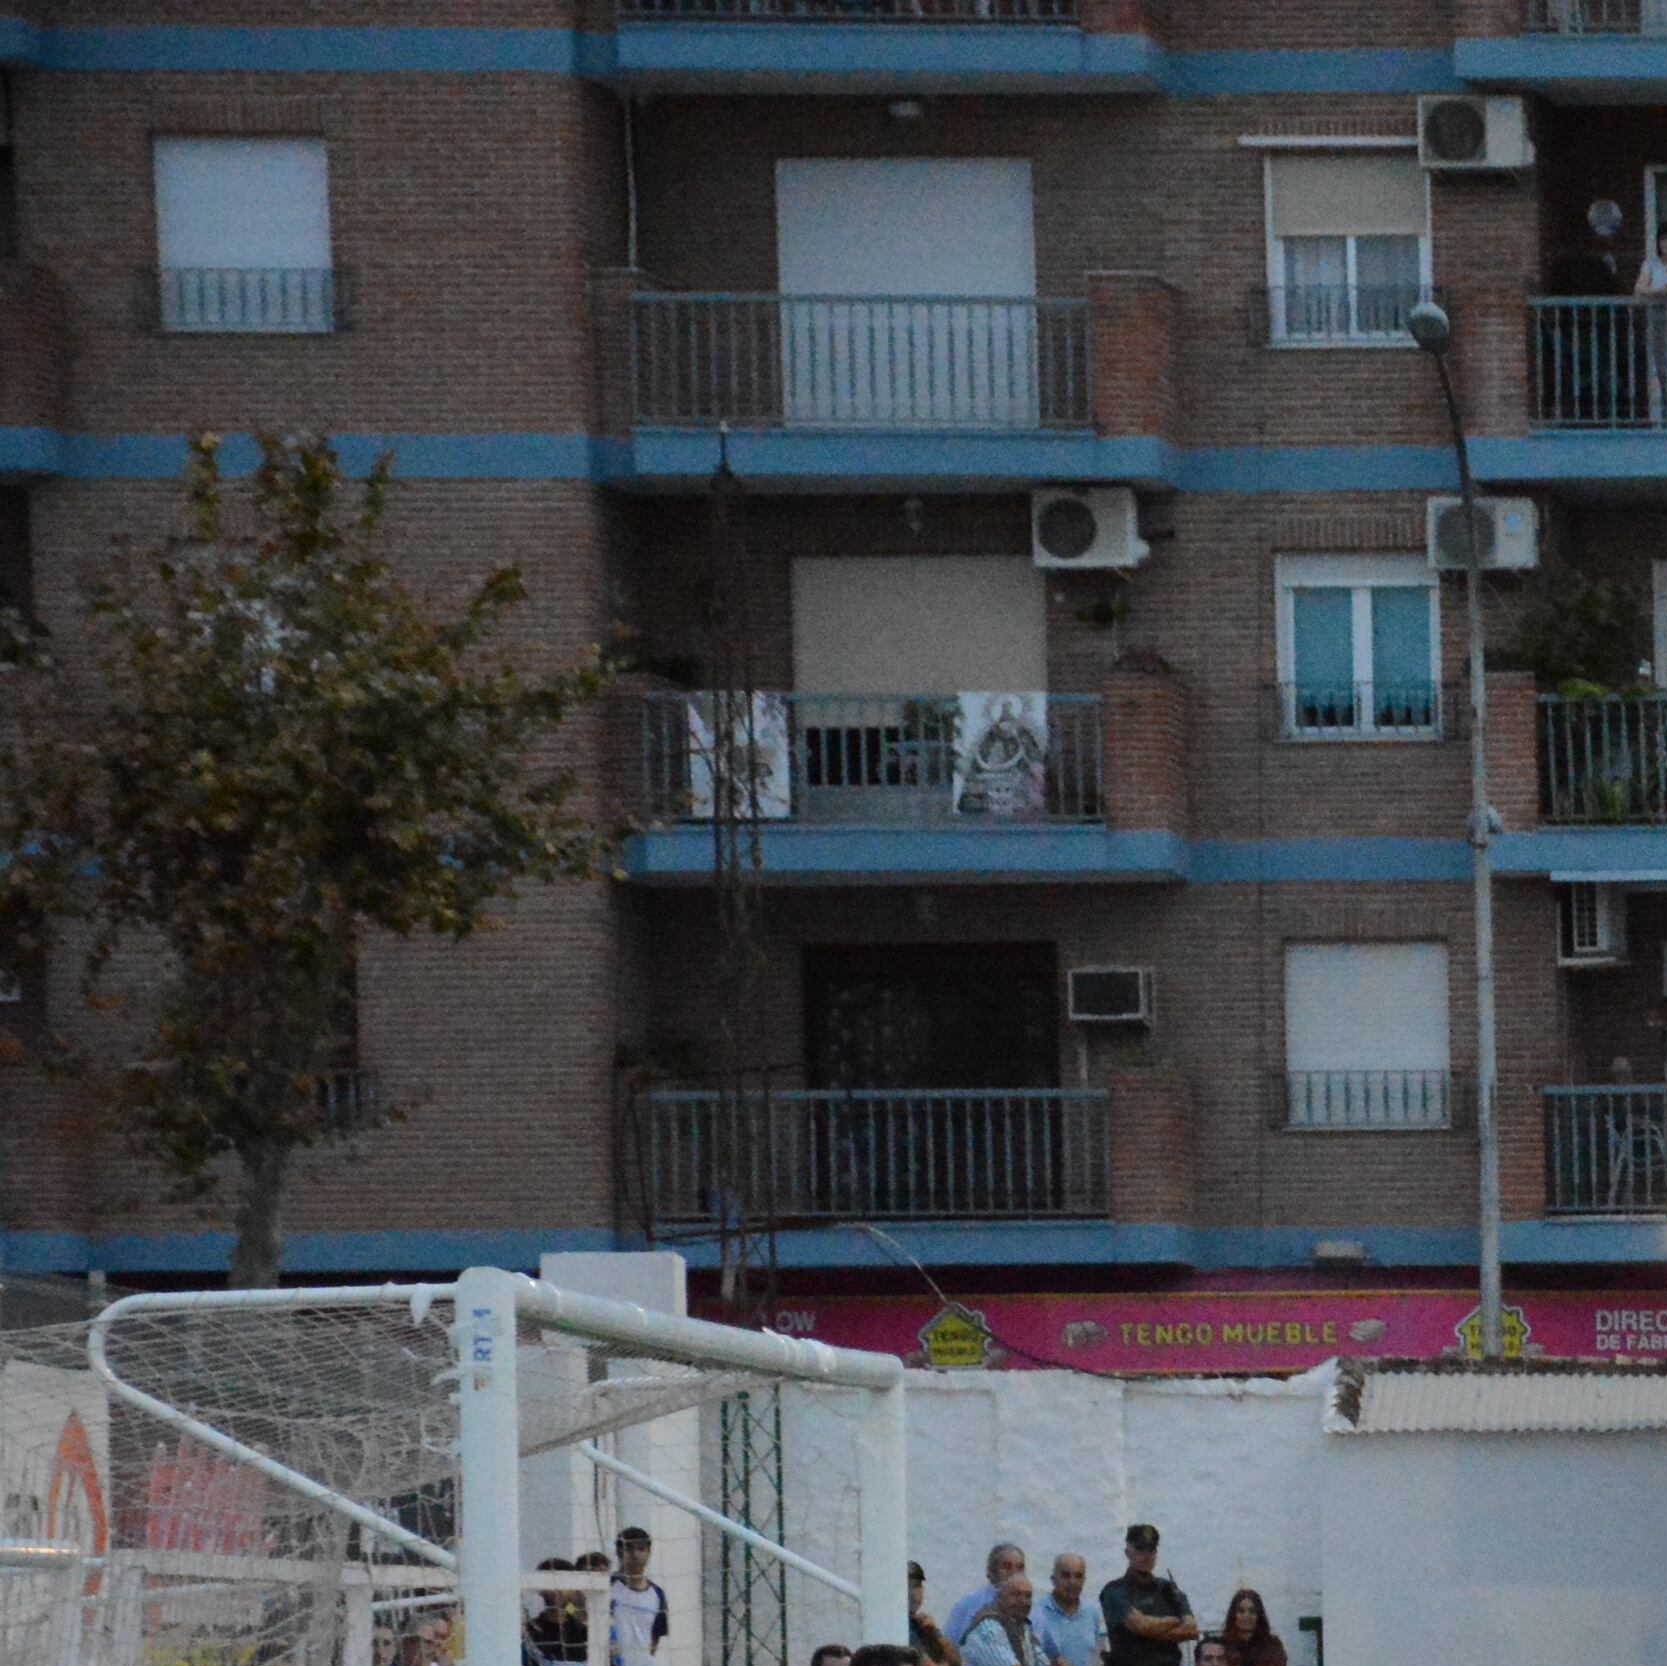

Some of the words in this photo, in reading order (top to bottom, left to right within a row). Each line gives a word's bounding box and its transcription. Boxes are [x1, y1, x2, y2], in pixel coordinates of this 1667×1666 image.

[1120, 1322, 1214, 1345] TENGO
[1222, 1321, 1338, 1345] MUEBLE
[1596, 1334, 1622, 1351] DE
